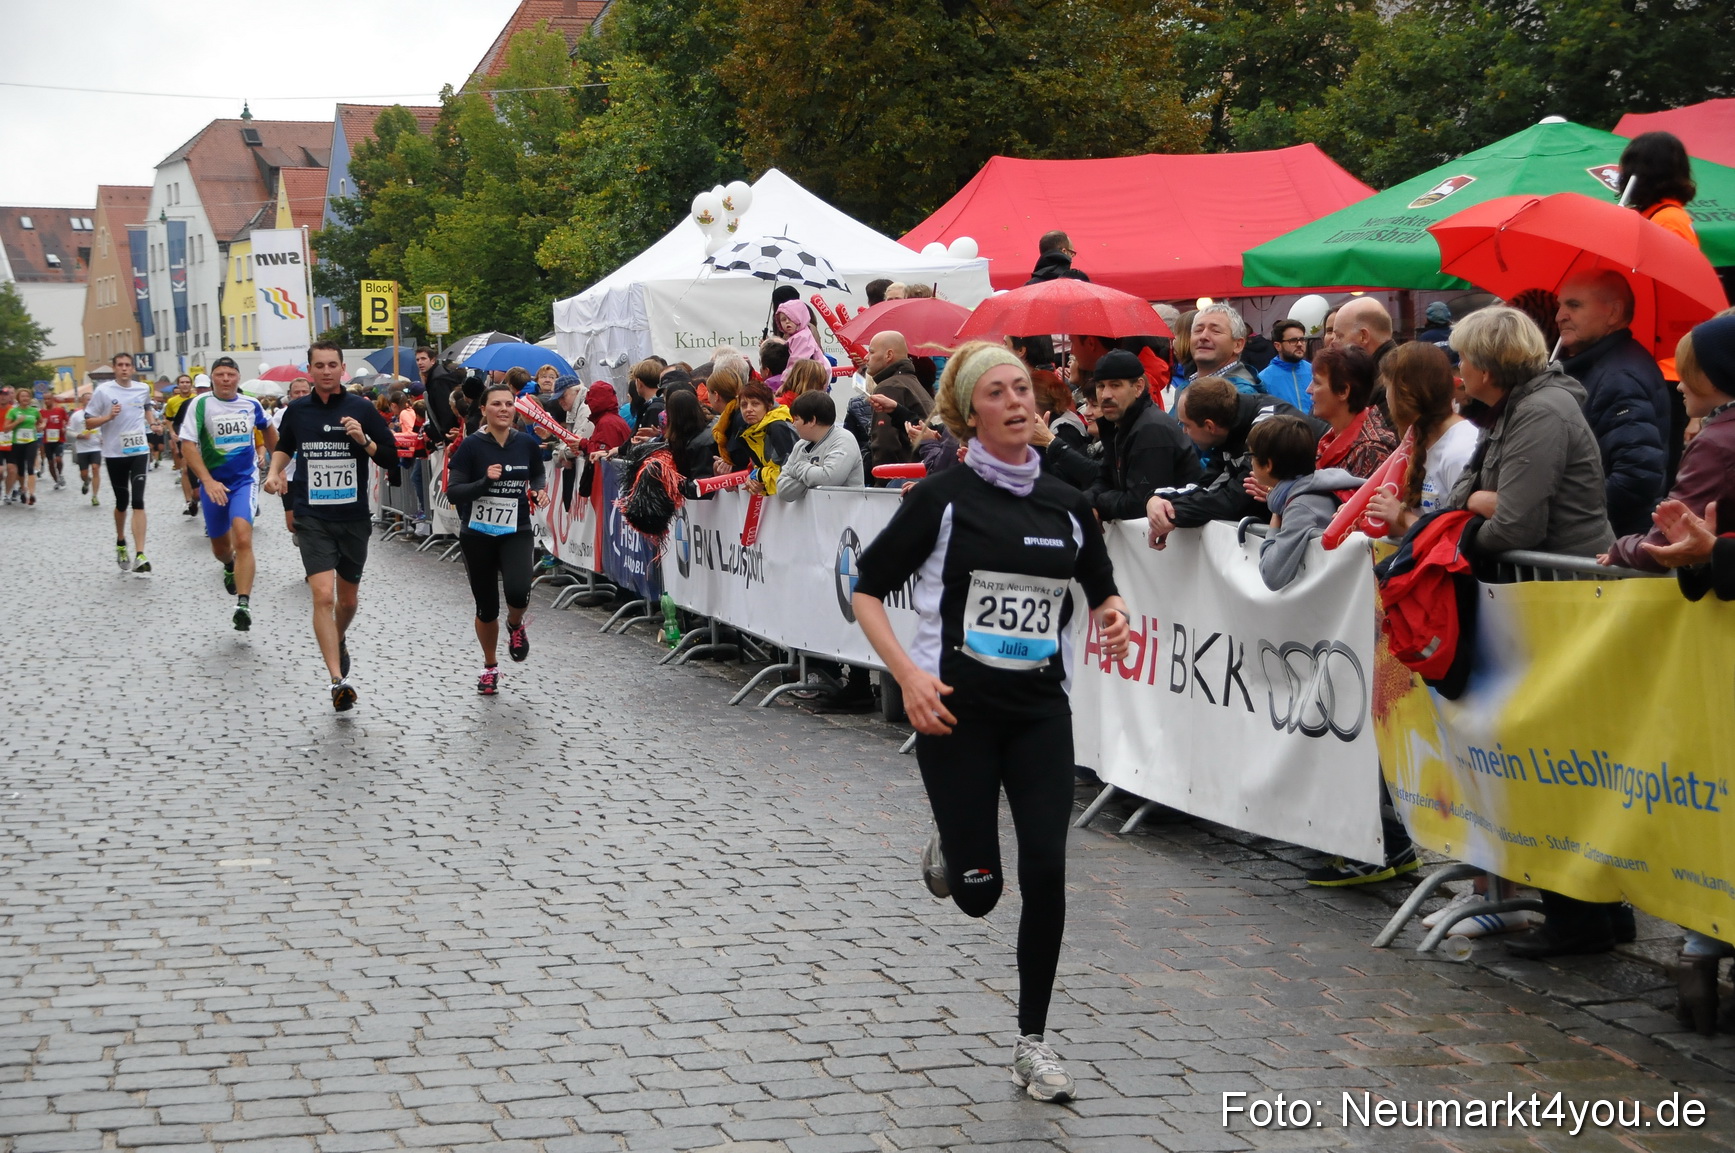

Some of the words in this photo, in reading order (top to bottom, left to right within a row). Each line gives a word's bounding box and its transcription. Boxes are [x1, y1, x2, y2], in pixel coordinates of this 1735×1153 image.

[366, 282, 393, 293] Block
[371, 297, 389, 323] B
[675, 331, 734, 348] Kinder
[217, 421, 248, 436] 3043
[302, 442, 350, 450] GRUNDSCHULE
[313, 471, 353, 488] 3176
[705, 479, 732, 492] Audi
[475, 505, 513, 524] 3177
[1030, 537, 1064, 547] PFLEIDERER
[973, 579, 1005, 590] PARTL
[1006, 583, 1051, 595] Neumarkt
[976, 595, 1051, 634] 2523
[998, 640, 1029, 657] Julia
[1084, 608, 1159, 686] Adi
[1169, 622, 1256, 713] BKK
[1546, 834, 1581, 853] Stufen
[1583, 842, 1650, 873] Gartenmauern
[964, 873, 994, 884] skinfit
